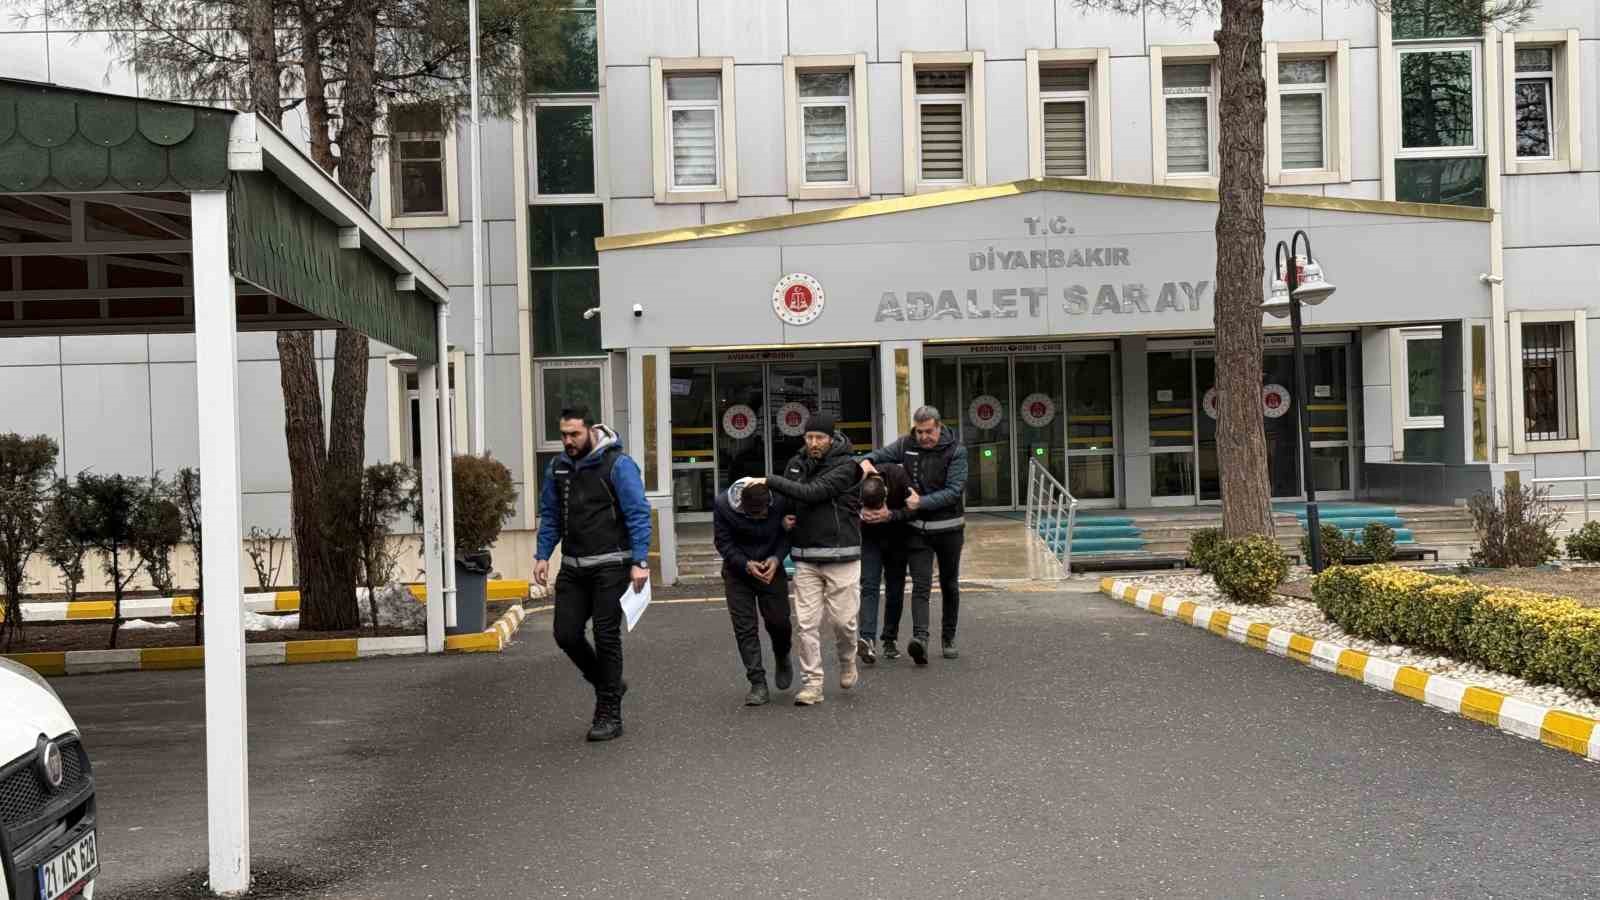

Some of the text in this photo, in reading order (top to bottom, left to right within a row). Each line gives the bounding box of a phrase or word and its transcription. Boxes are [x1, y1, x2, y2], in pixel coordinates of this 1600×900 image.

[1023, 215, 1075, 236] T.C.
[968, 247, 1132, 272] DİYARBAKIR
[874, 280, 1217, 323] ADALET SARAY
[44, 835, 95, 899] 21 ACS 628
